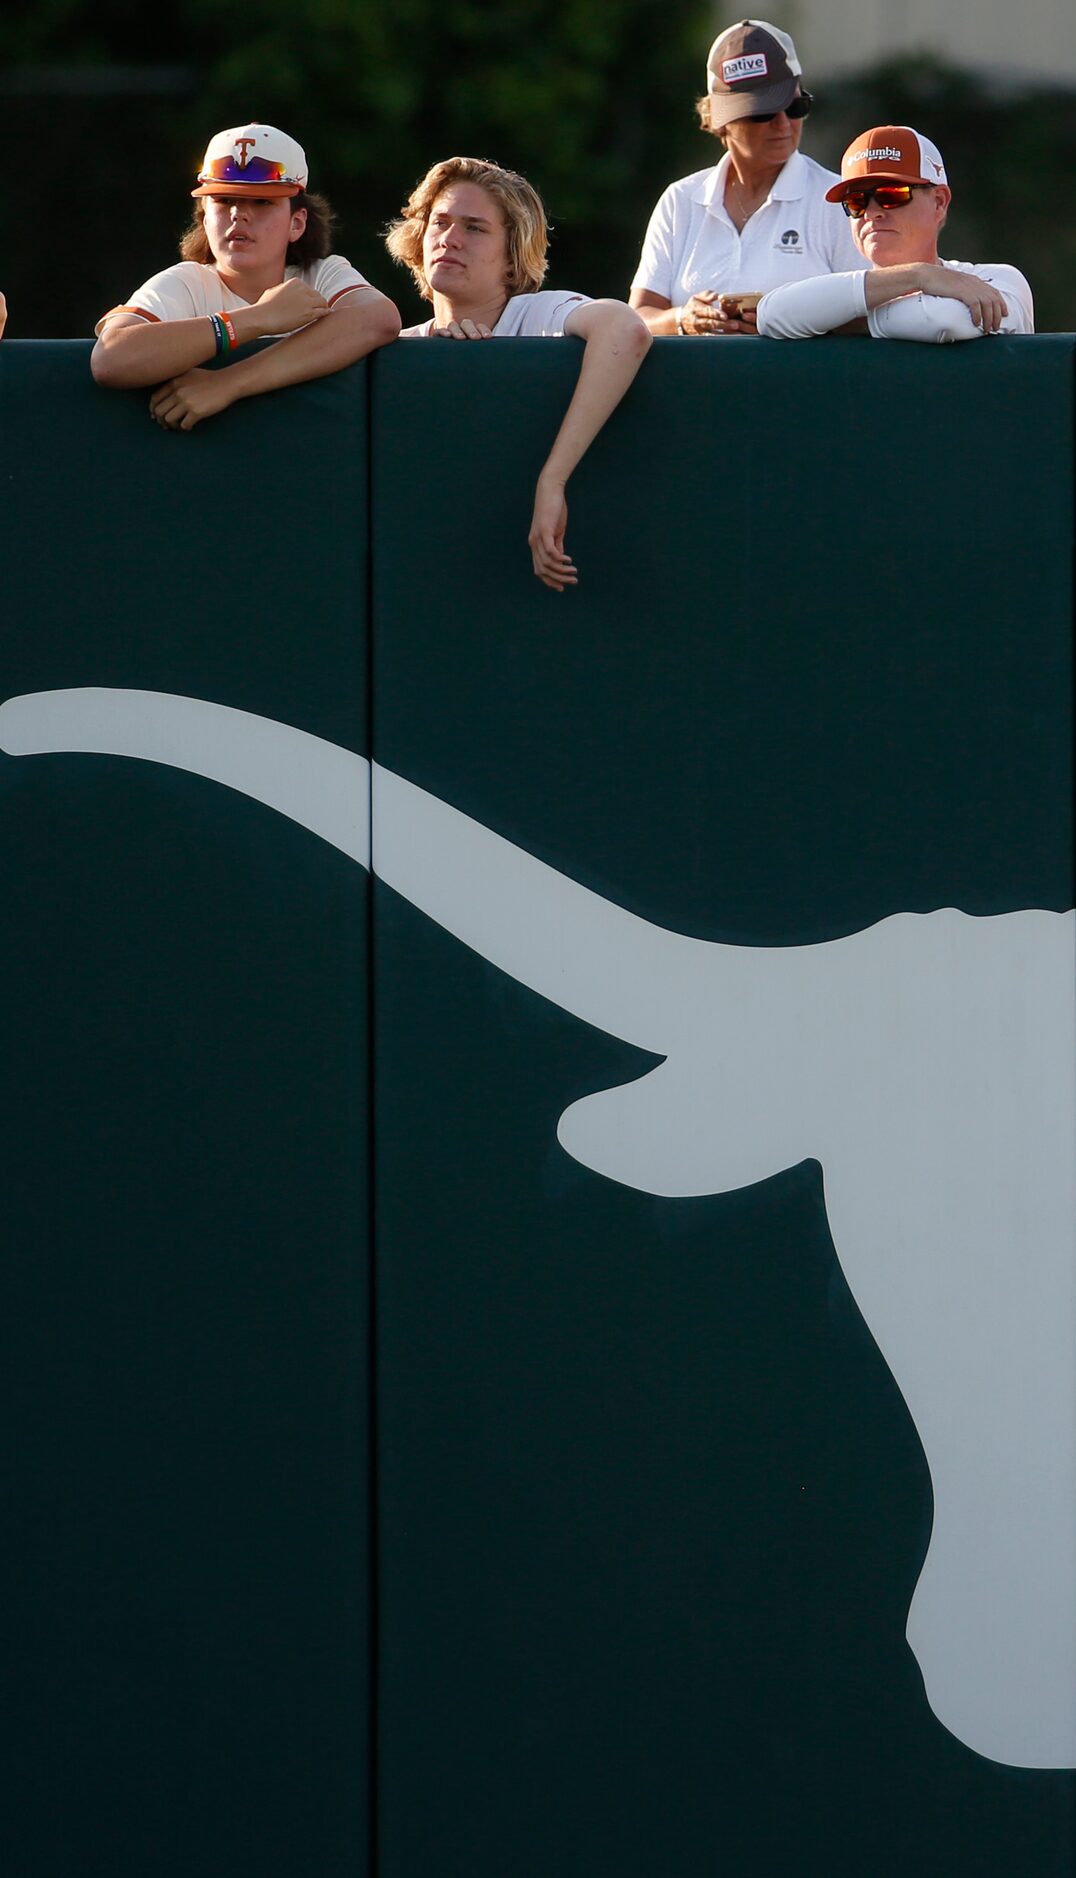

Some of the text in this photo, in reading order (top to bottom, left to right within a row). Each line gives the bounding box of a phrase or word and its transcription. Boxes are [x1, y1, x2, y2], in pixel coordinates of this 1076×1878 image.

[724, 58, 763, 75] native
[235, 138, 256, 170] T
[854, 146, 901, 161] Columbia
